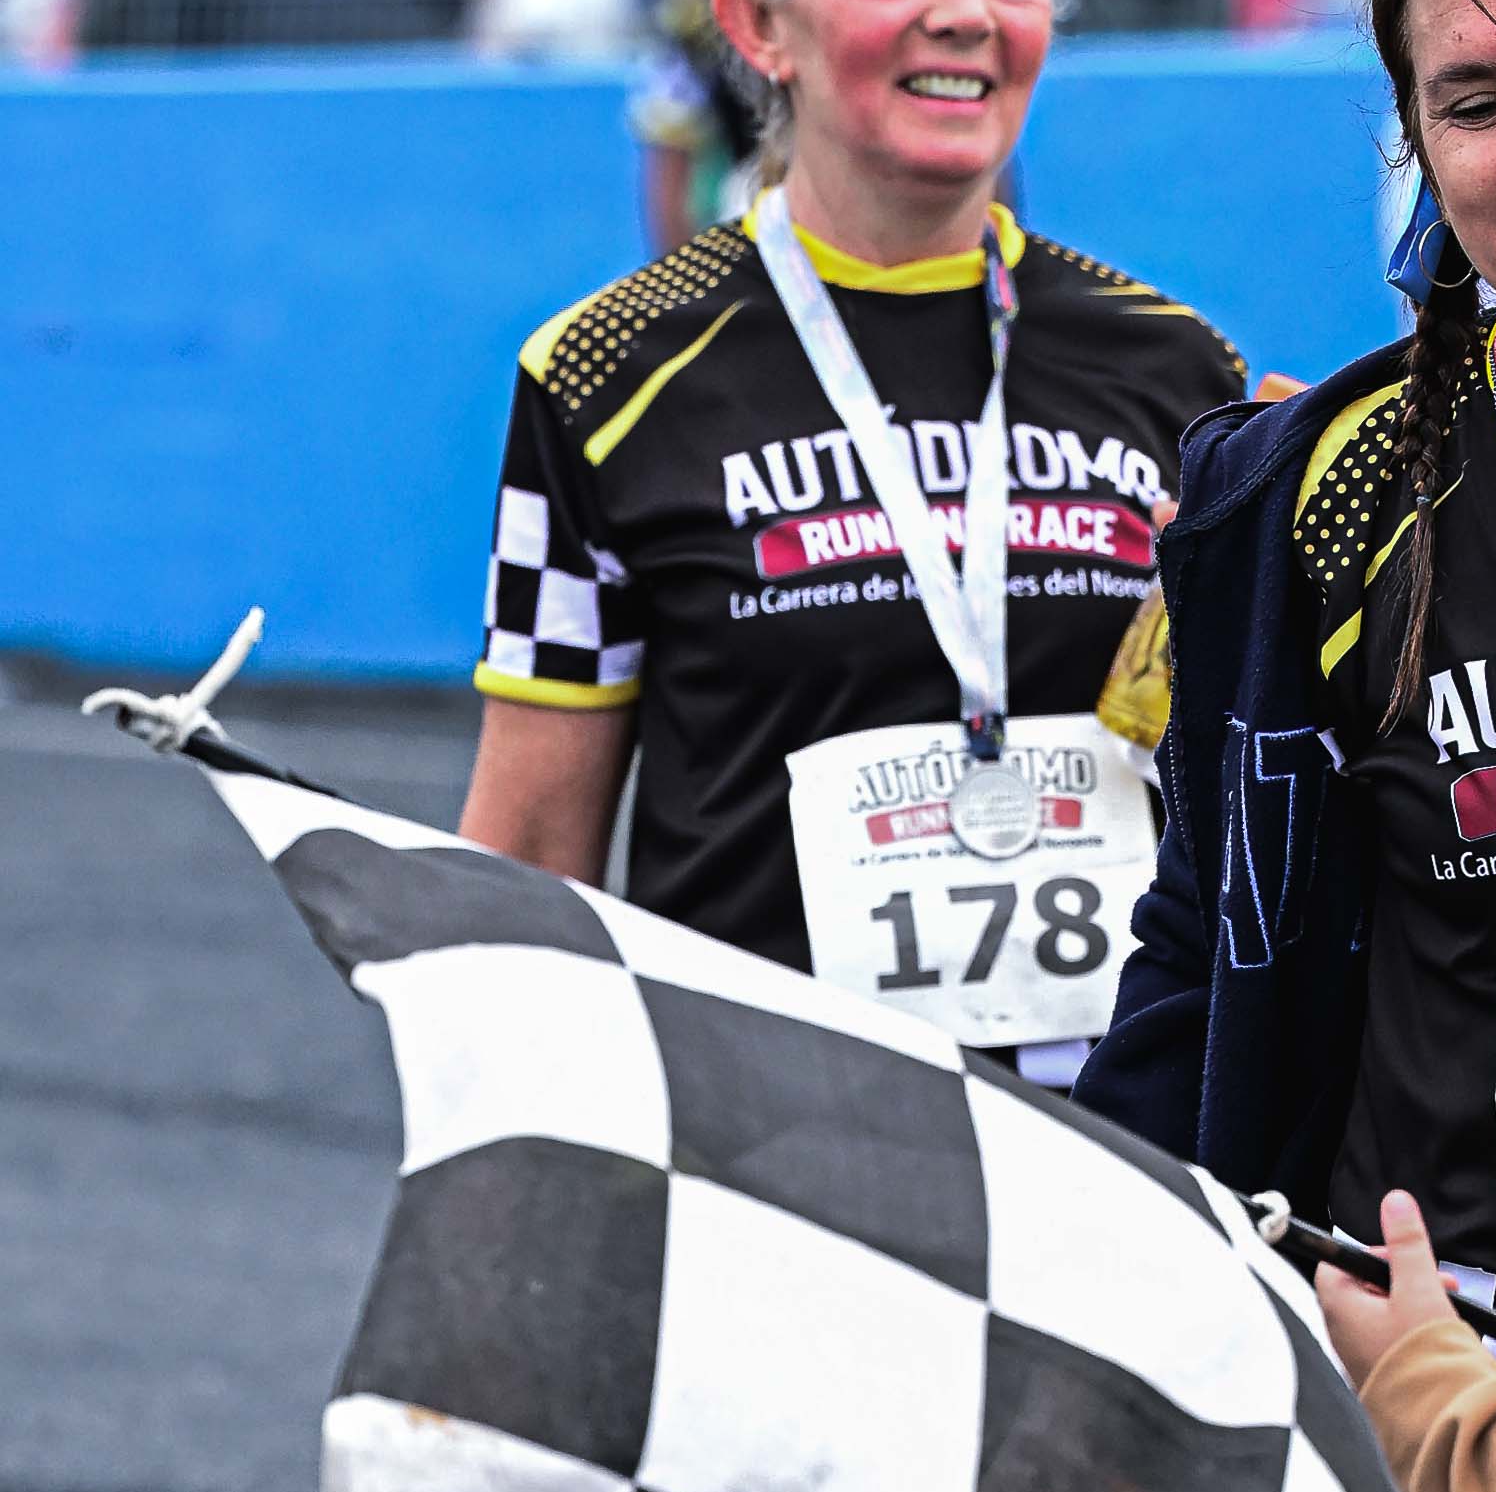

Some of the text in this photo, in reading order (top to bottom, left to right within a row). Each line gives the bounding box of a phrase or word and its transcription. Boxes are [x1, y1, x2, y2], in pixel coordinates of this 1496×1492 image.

[1007, 505, 1117, 556] RACE
[730, 593, 757, 619] La
[760, 576, 856, 615] Carrera
[862, 572, 899, 601] de
[1050, 568, 1088, 597] del
[1431, 854, 1456, 880] La
[870, 875, 1109, 990] 178
